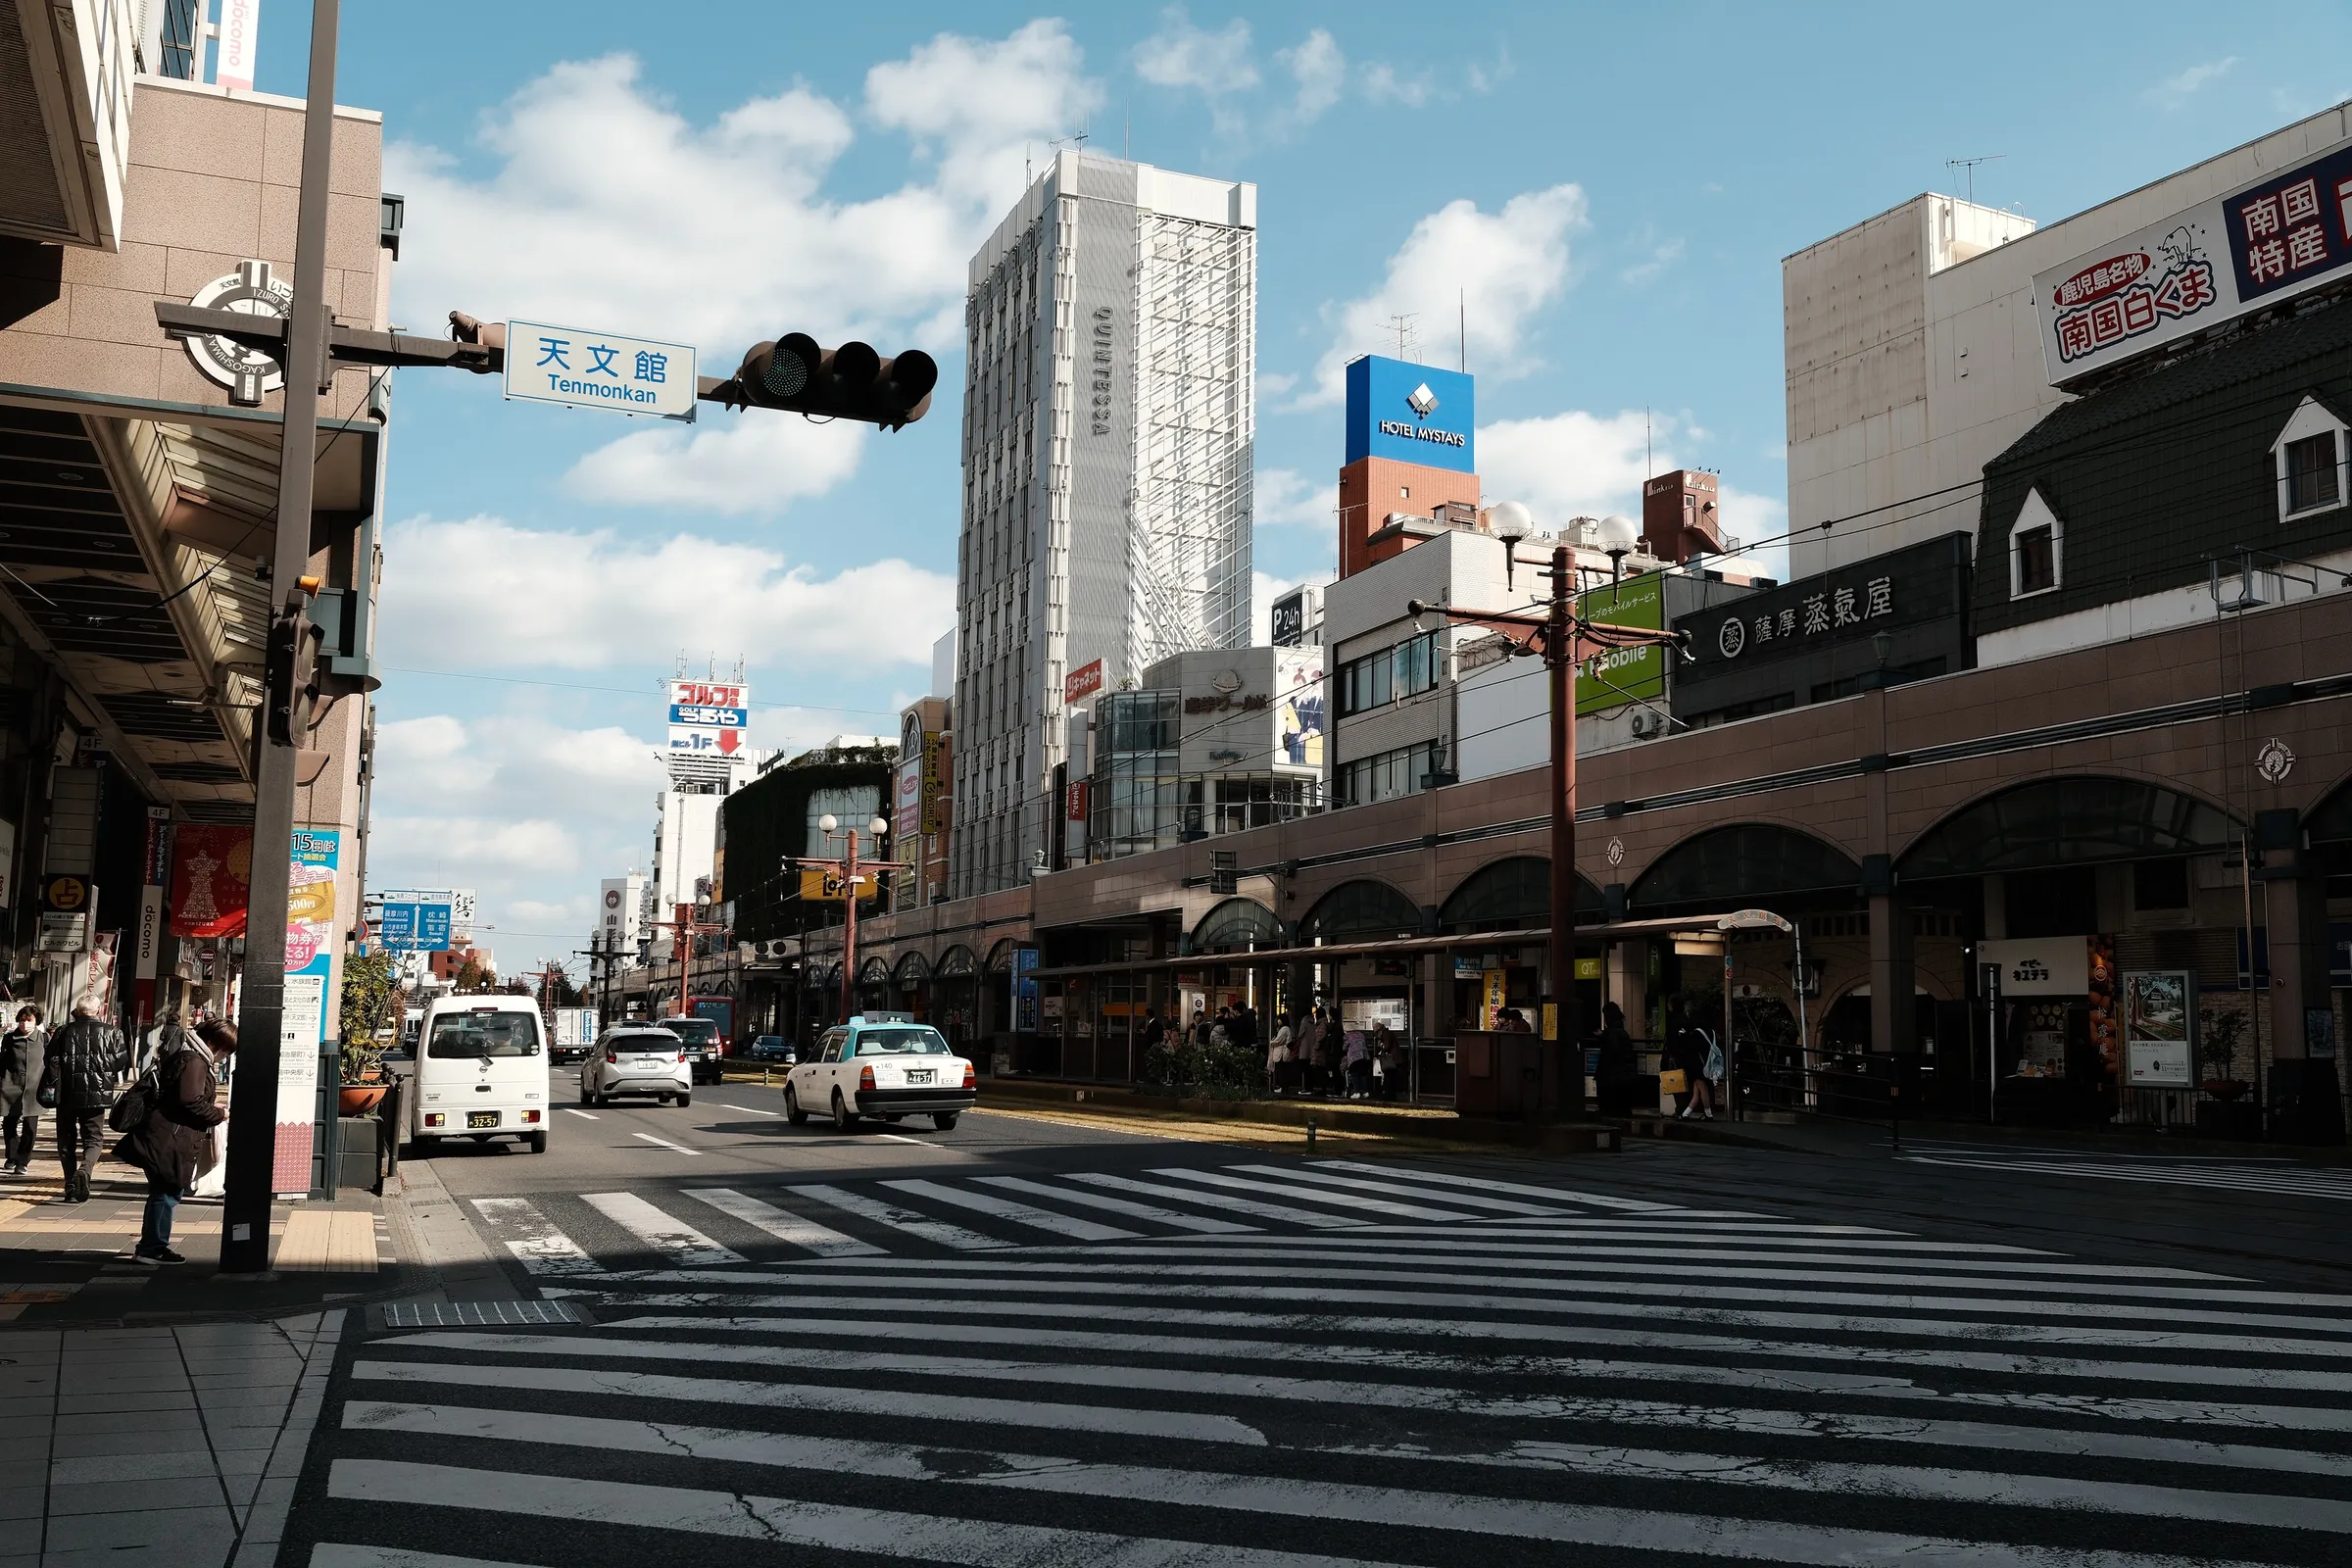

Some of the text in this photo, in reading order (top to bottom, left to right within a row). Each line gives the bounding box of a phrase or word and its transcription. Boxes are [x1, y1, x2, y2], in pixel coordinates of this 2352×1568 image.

[2241, 178, 2320, 241] 南国
[2248, 223, 2328, 283] 特産
[2060, 253, 2144, 306] 鹿児島名物
[253, 288, 280, 304] IZURO
[2059, 265, 2212, 357] 南国白くま
[536, 336, 668, 384] 天文館
[1095, 306, 1114, 434] QUINTESSA
[547, 372, 658, 405] Tenmonkan
[1379, 420, 1466, 448] HOTEL MYSTAYS
[1274, 606, 1300, 636] P 24h
[678, 709, 740, 725] つるや
[83, 737, 102, 749] 4F
[152, 808, 166, 817] 4F
[56, 878, 78, 906] 占
[142, 905, 156, 960] docomo
[474, 1117, 498, 1128] 32-57
